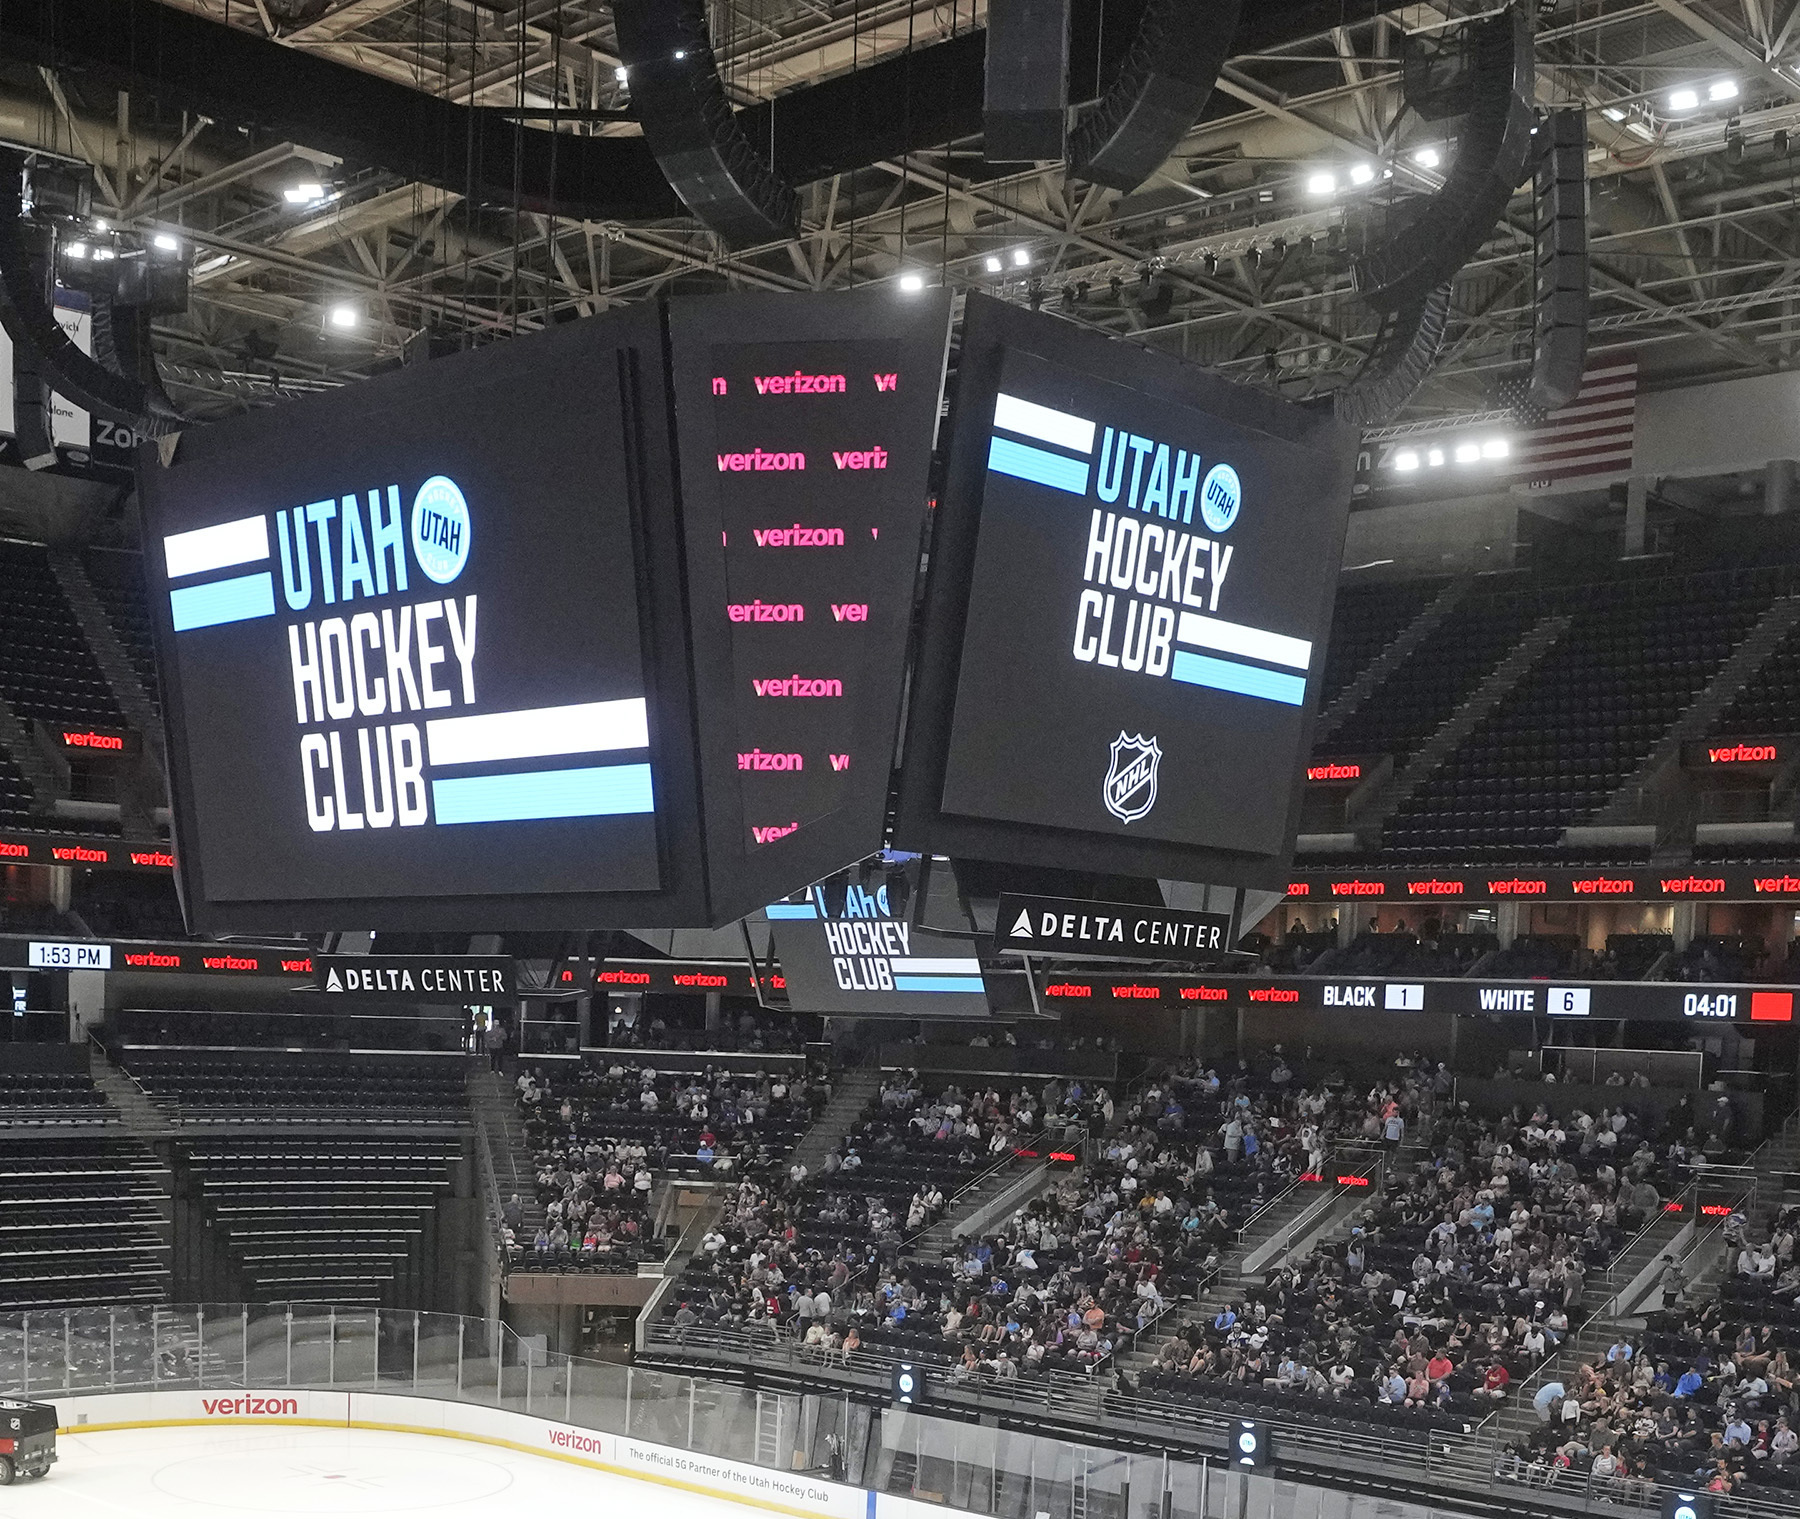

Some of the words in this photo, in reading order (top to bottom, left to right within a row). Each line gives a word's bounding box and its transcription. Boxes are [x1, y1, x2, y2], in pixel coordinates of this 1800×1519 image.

[754, 370, 846, 394] verizon
[1097, 426, 1201, 525] UTAH
[1206, 479, 1235, 519] UTAH
[276, 484, 408, 611] UTAH
[421, 507, 462, 556] UTAH
[753, 523, 845, 547] verizon
[1084, 508, 1234, 612] HOCKEY
[1073, 588, 1175, 677] CLUB
[288, 594, 478, 724] HOCKEY
[752, 674, 843, 697] verizon
[63, 731, 123, 749] verizon
[1709, 743, 1777, 762] verizon
[300, 722, 429, 832] CLUB
[1114, 758, 1150, 802] NHL
[824, 921, 911, 956] HOCKEY
[1040, 912, 1124, 943] DELTA
[1134, 919, 1221, 950] CENTER
[39, 945, 71, 966] 1:53
[77, 946, 101, 966] PM
[203, 955, 258, 970] verizon
[1179, 985, 1228, 1000] verizon
[346, 970, 416, 992] DELTA
[420, 971, 504, 993] CENTER
[834, 957, 893, 990] CLUB
[1323, 986, 1376, 1010] BLACK
[1401, 988, 1408, 1008] 1
[1480, 989, 1535, 1012] WHITE
[1563, 991, 1574, 1012] 6
[1684, 994, 1737, 1018] 04:01
[202, 1393, 297, 1415] verizon
[548, 1429, 601, 1455] verizon
[629, 1447, 644, 1460] The
[645, 1451, 674, 1468] official
[675, 1457, 687, 1470] 5G
[689, 1461, 720, 1478] Partner
[722, 1468, 732, 1480] of
[733, 1471, 747, 1484] the
[749, 1475, 770, 1490] Utah
[772, 1480, 805, 1500] Hockey
[807, 1487, 829, 1502] Club
